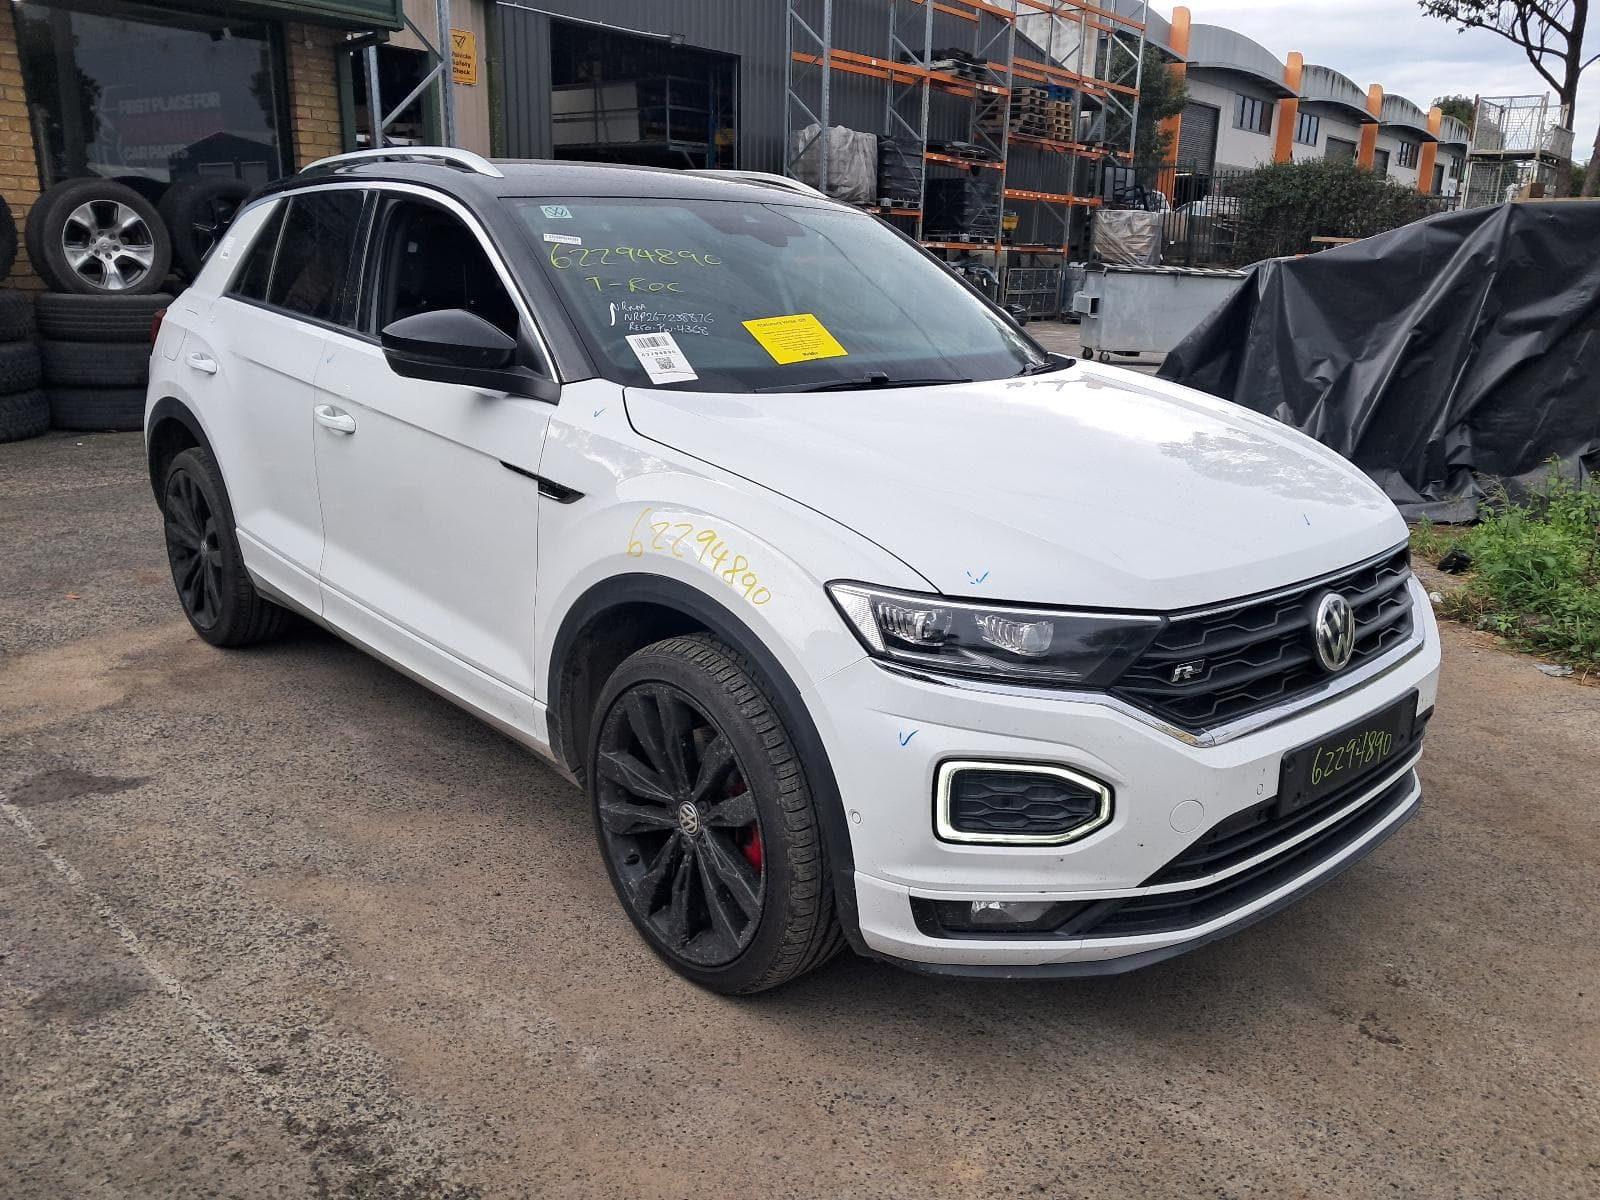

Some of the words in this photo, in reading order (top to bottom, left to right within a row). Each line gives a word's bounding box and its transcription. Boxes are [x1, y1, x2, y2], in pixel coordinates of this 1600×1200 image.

[453, 67, 471, 75] Check
[151, 94, 193, 113] PLACE
[192, 90, 222, 110] FOR
[626, 507, 772, 606] 62294890
[1311, 731, 1393, 785] 62294890
